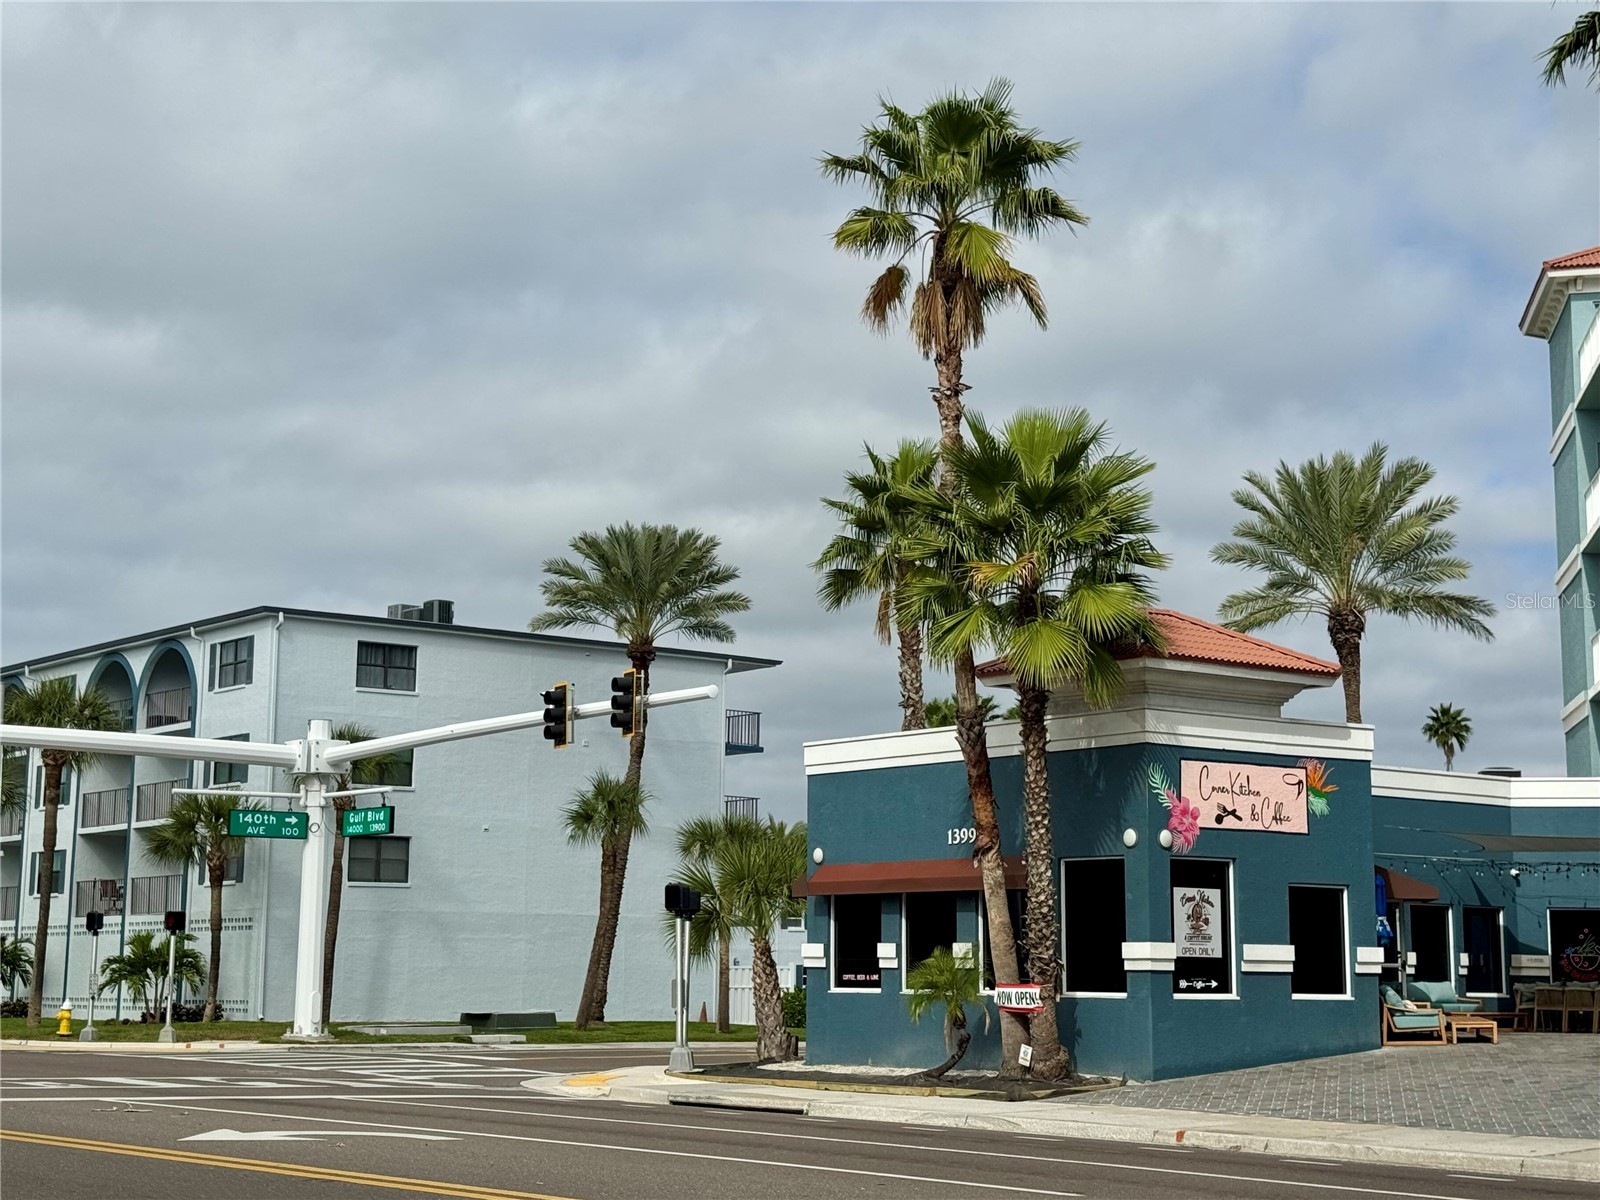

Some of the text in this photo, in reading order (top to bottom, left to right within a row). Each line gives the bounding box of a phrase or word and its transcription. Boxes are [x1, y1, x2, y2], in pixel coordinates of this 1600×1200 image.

[1199, 765, 1262, 807] Corner Kitchen
[239, 813, 276, 824] 140th
[349, 810, 384, 823] Gulf Blvd
[1250, 797, 1293, 829] & Coffee
[246, 826, 299, 836] AVE 100
[346, 822, 386, 834] 14000 13900
[947, 827, 978, 845] 1399
[1181, 947, 1215, 956] OPEN DAILY
[996, 990, 1040, 1006] NOW OPEN!
